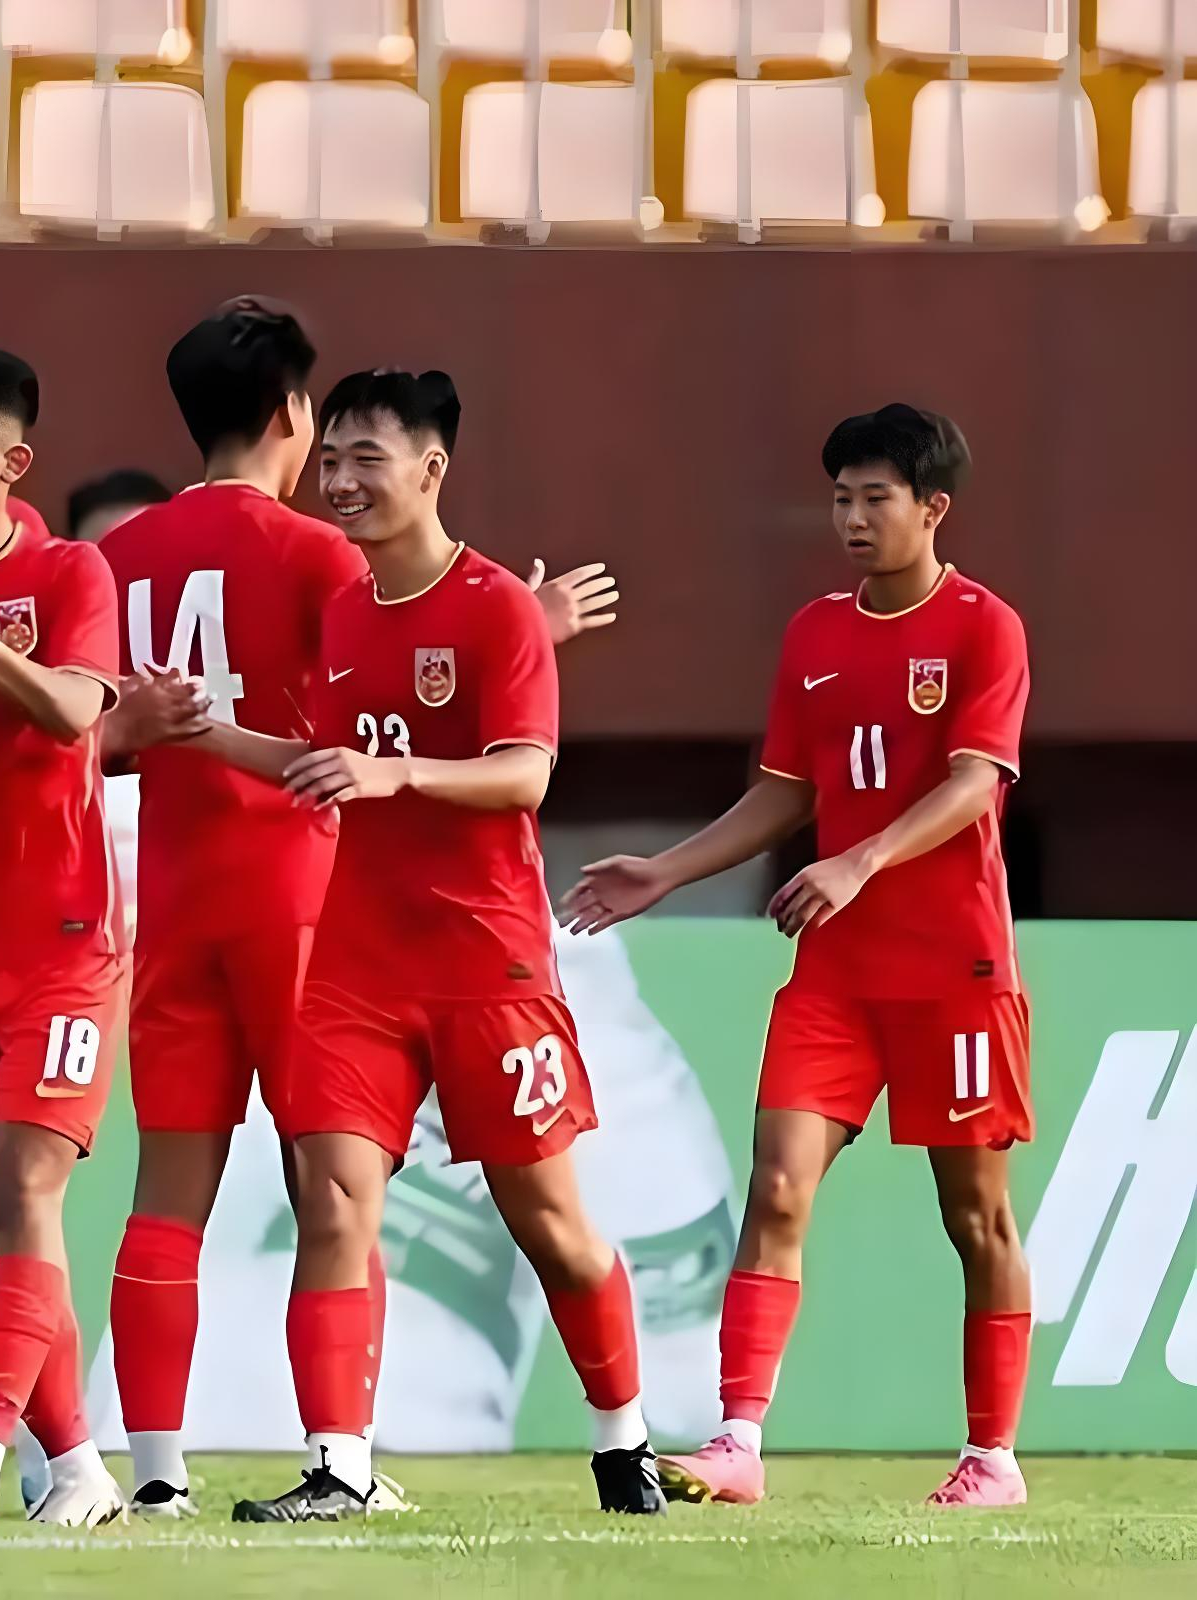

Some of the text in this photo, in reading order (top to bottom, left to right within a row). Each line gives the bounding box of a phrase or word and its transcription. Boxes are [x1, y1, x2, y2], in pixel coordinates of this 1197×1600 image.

[850, 724, 886, 790] 11
[43, 1015, 101, 1086] 18
[501, 1033, 567, 1118] 23
[953, 1031, 990, 1099] 11
